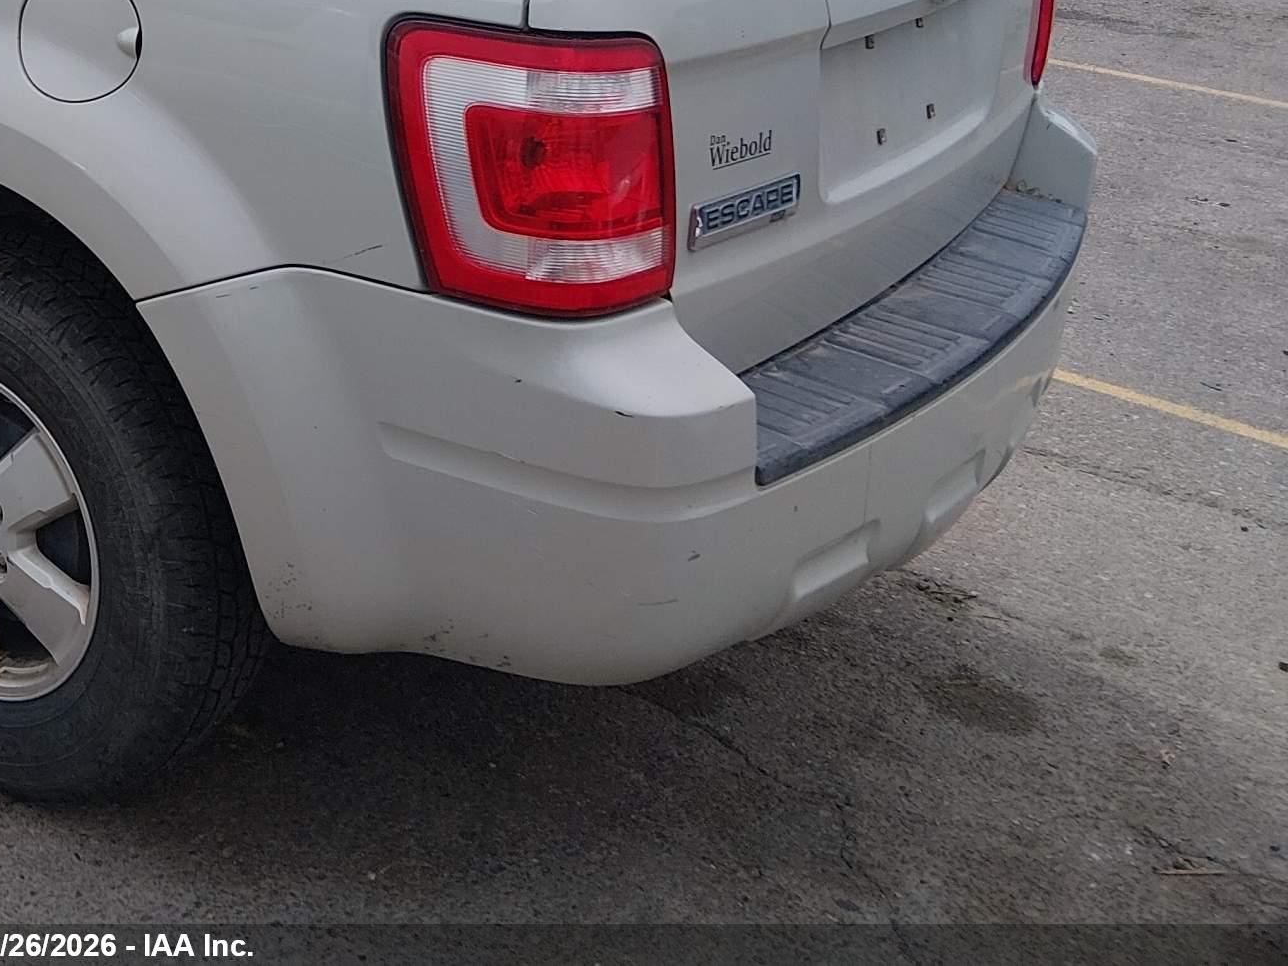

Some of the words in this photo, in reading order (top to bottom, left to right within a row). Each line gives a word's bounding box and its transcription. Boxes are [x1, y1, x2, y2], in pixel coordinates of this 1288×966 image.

[709, 134, 727, 146] Dan
[709, 129, 773, 167] Wiebold
[705, 182, 794, 231] ESCAPE
